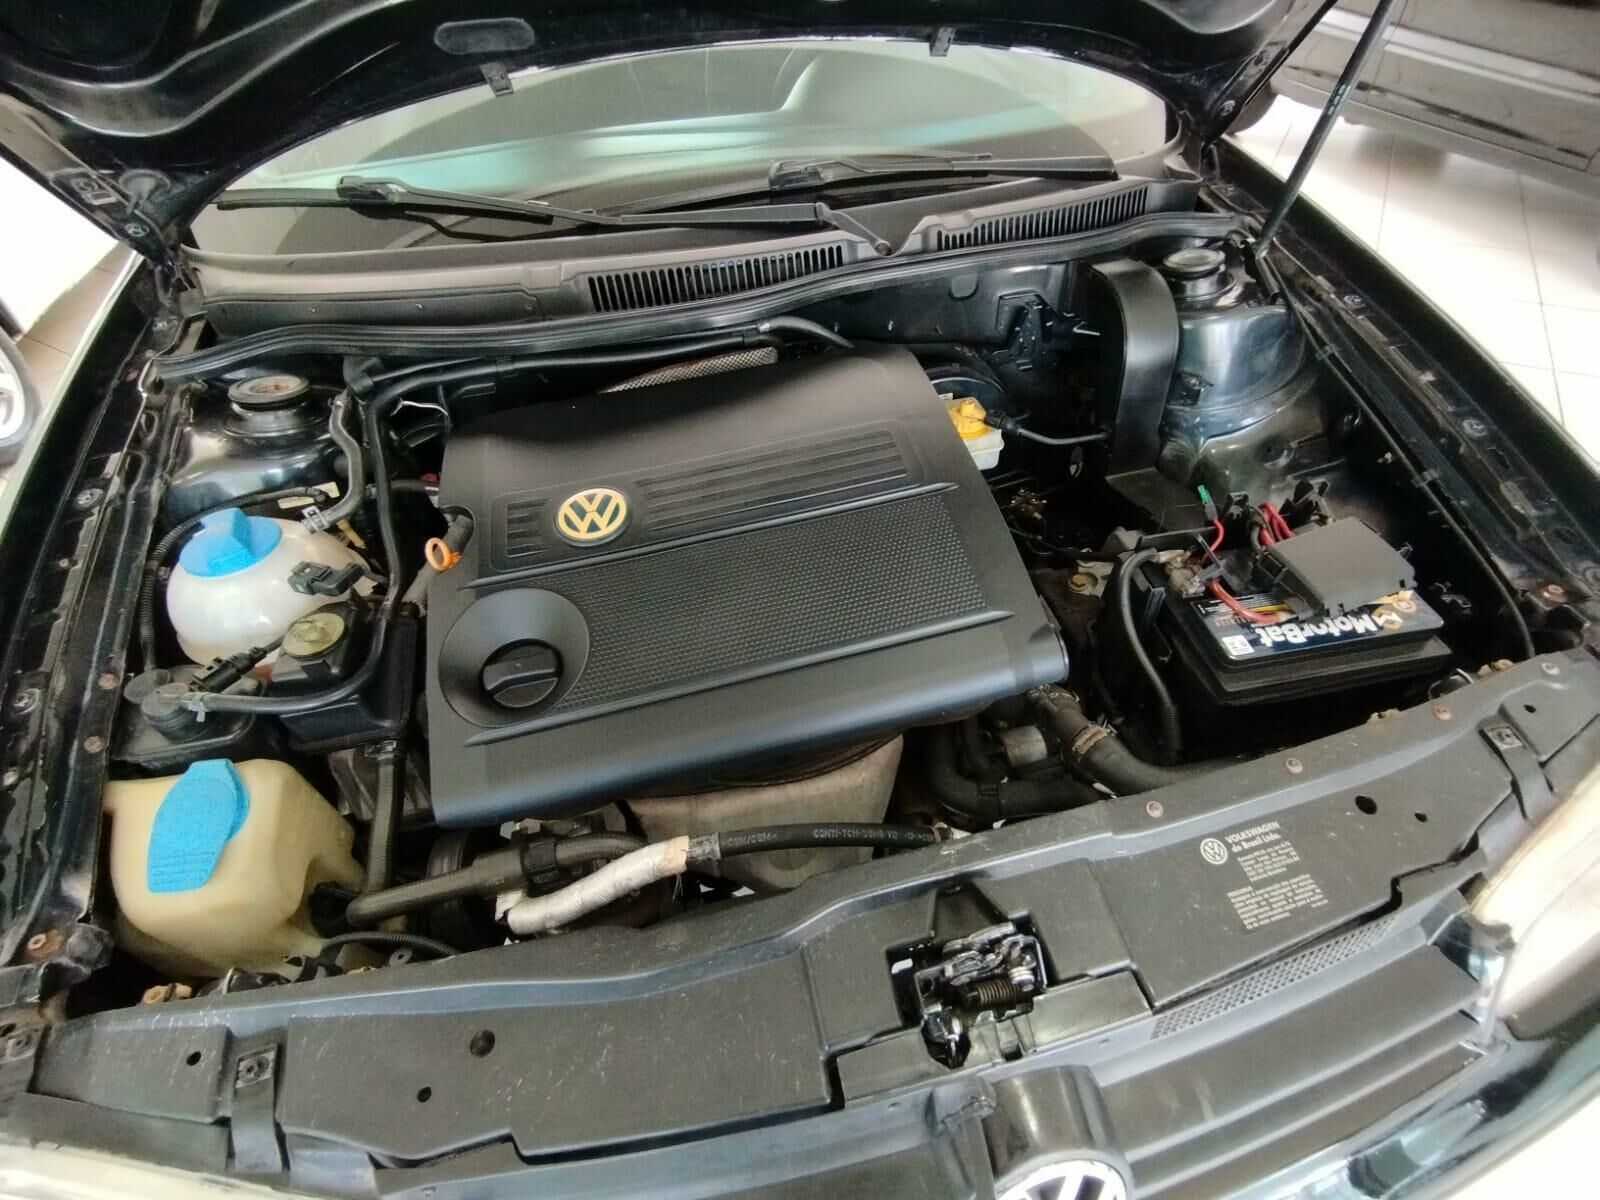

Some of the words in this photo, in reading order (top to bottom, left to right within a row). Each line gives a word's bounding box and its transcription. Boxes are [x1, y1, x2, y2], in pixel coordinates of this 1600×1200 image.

[557, 487, 627, 540] VW
[1254, 612, 1379, 648] MotorBat
[1224, 821, 1281, 844] VOLKSWAGEN
[1200, 837, 1229, 865] VW
